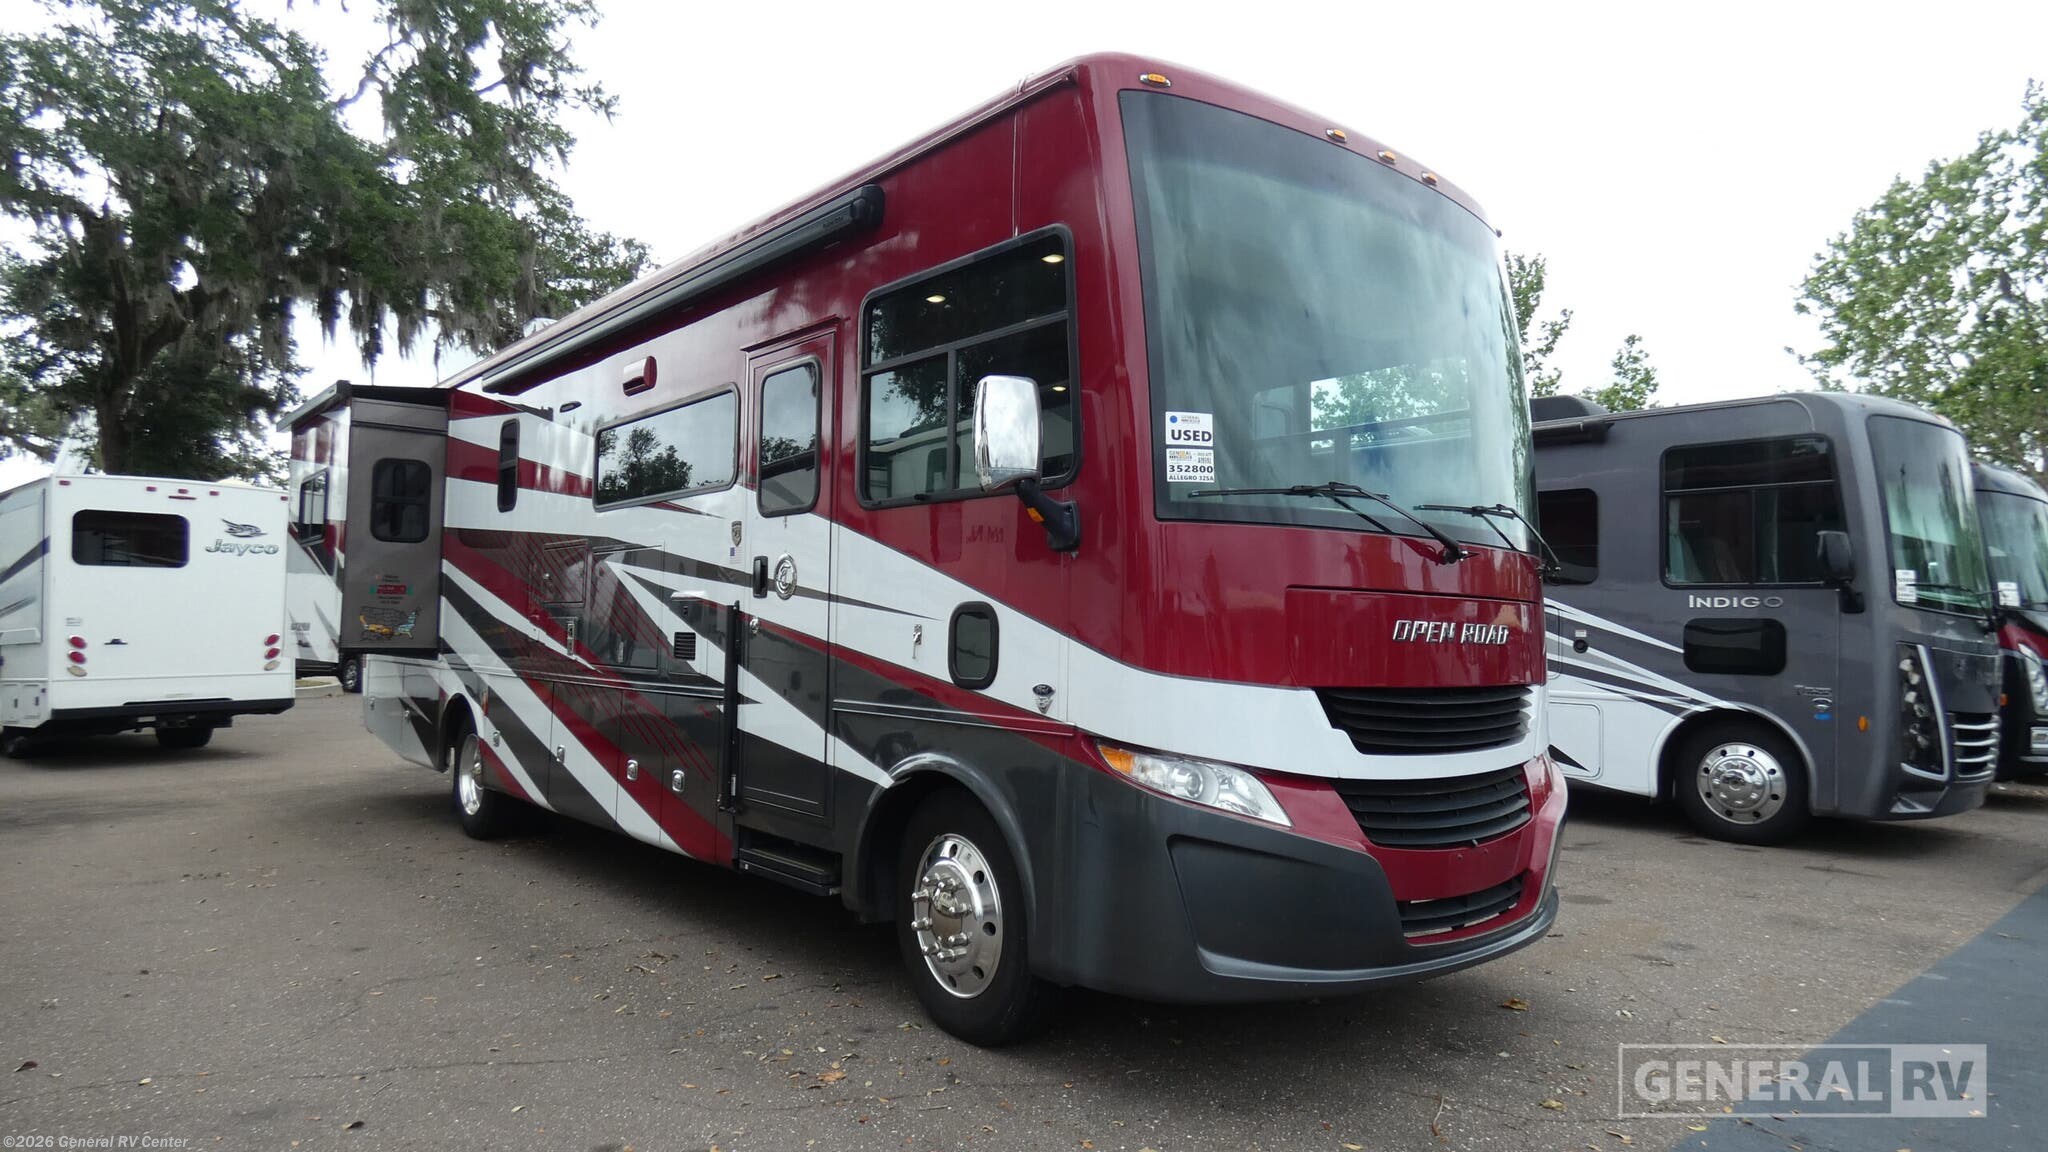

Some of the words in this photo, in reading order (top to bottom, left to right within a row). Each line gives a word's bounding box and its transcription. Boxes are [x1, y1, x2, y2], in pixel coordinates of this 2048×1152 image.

[1171, 429, 1212, 442] USED
[1168, 464, 1213, 474] 352800
[205, 538, 280, 557] Jayco
[1392, 619, 1457, 643] OPEN
[1460, 622, 1509, 645] ROAD
